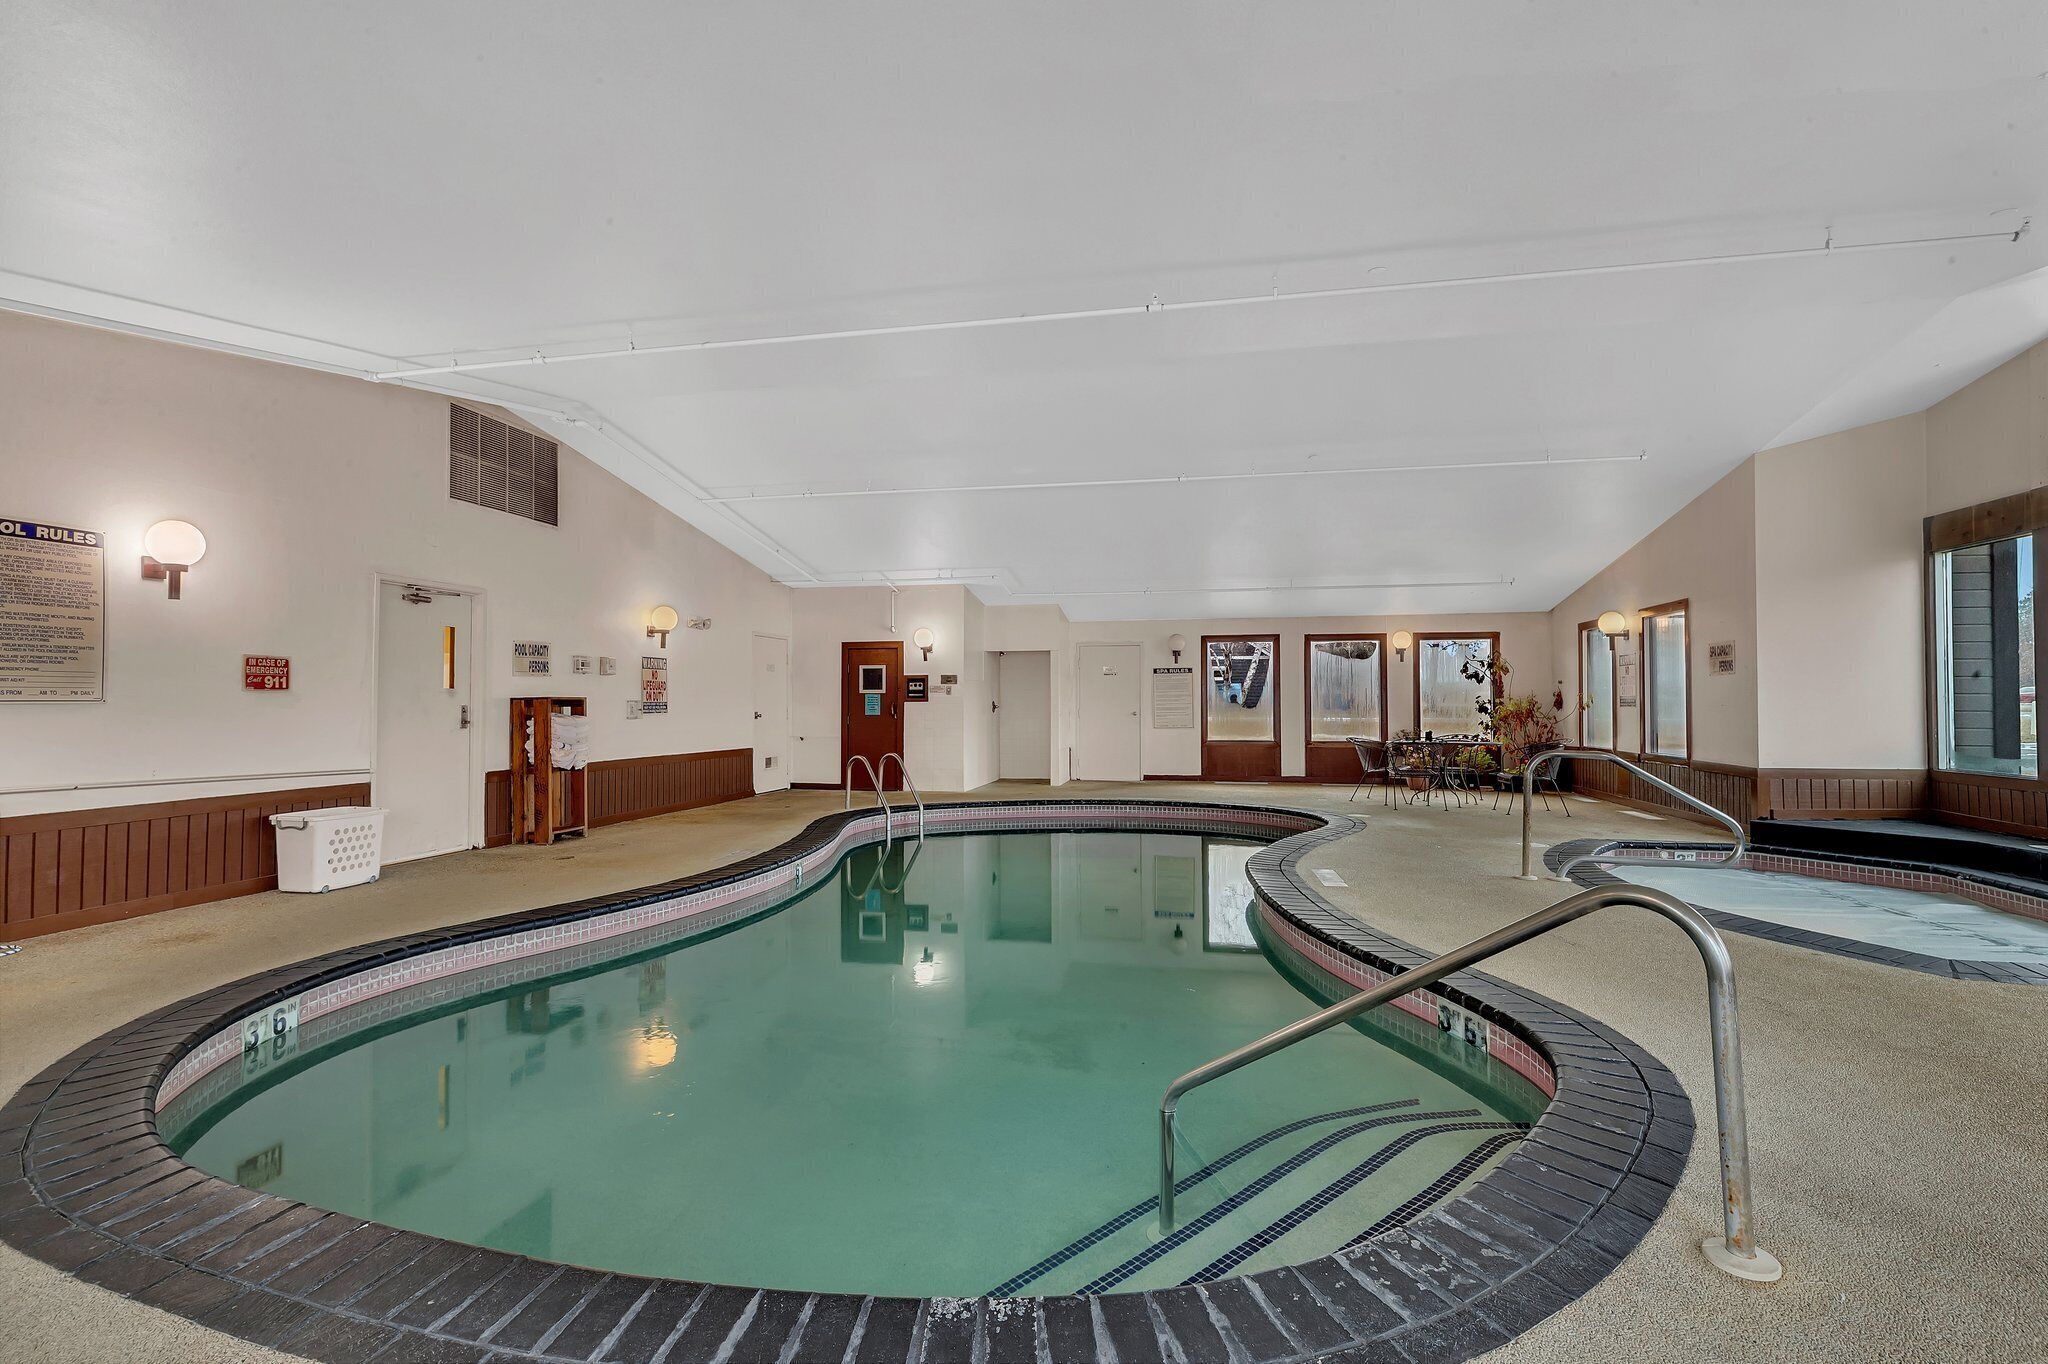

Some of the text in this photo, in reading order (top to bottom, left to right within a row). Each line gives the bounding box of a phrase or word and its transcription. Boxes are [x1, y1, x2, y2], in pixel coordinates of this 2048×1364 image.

[0, 521, 26, 536] OL
[36, 526, 97, 545] RULES
[514, 643, 549, 657] POOL CAPACITY
[1717, 643, 1733, 657] CAPACITY
[248, 658, 287, 667] IN CASE OF
[528, 660, 549, 673] PERSONS
[1718, 660, 1734, 673] PERSONS
[246, 666, 288, 675] EMERGENCY
[651, 670, 659, 680] NO
[247, 675, 287, 689] Call 911
[643, 680, 667, 691] LIFEGUARD
[645, 691, 664, 701] ON DUTY
[245, 1020, 259, 1052] 3
[272, 1007, 287, 1036] 6
[287, 1001, 297, 1013] IN
